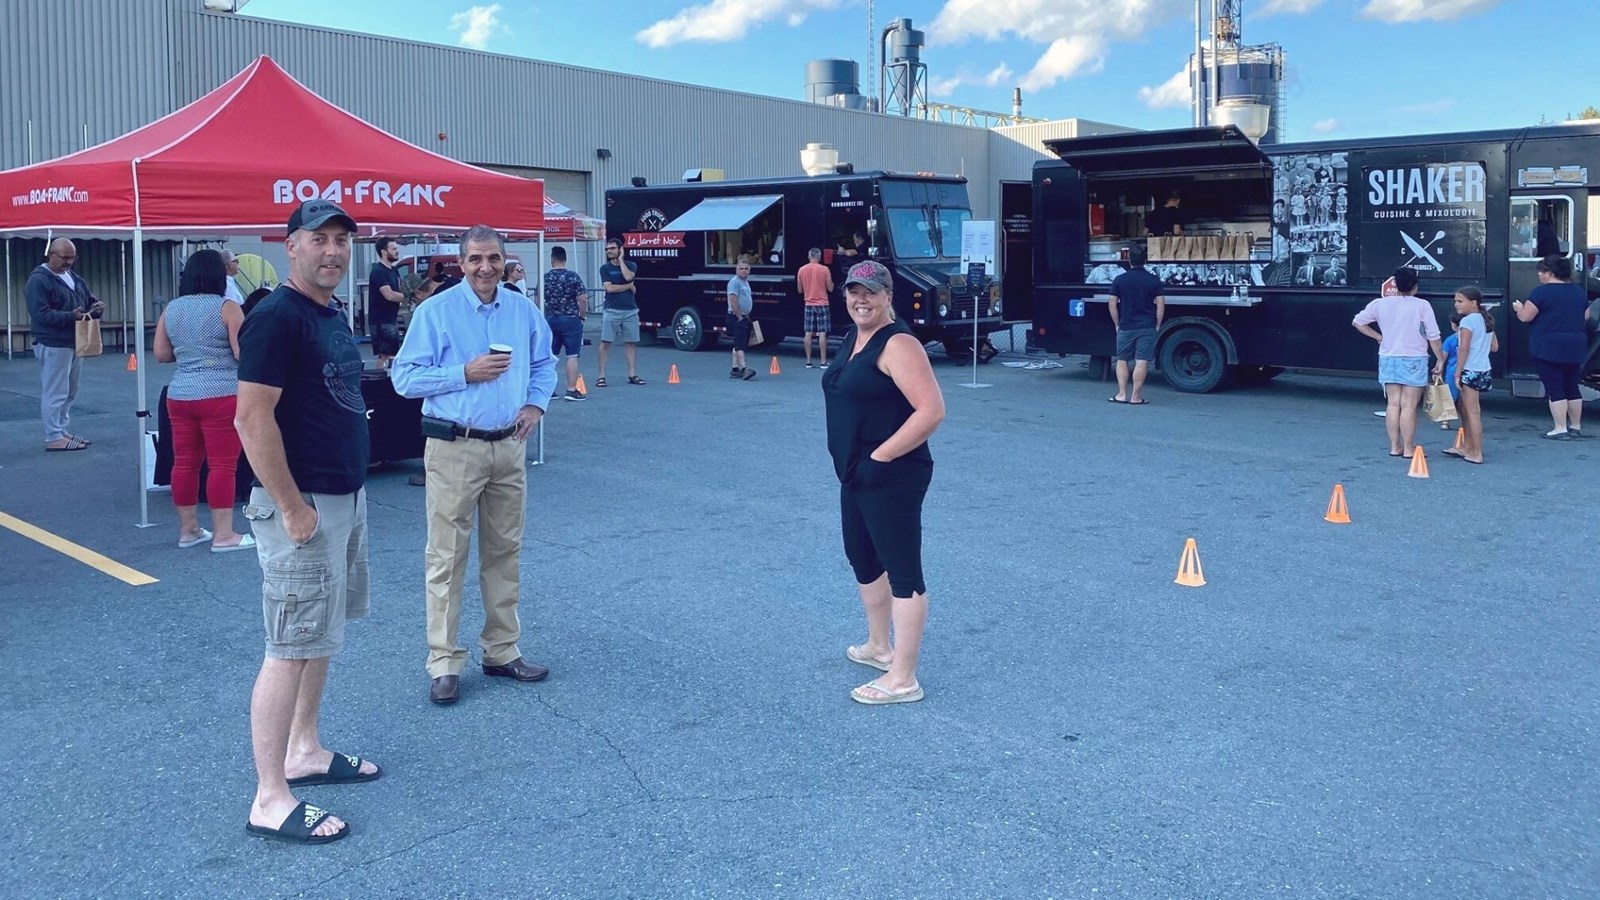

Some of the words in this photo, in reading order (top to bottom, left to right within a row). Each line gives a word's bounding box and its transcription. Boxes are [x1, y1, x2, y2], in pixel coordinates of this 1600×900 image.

[1368, 165, 1485, 206] SHAKER
[273, 179, 453, 208] BOA-FRANC
[641, 210, 652, 223] FOOD
[652, 210, 665, 223] TRUCK
[1374, 210, 1410, 218] CUISINE
[1414, 209, 1421, 217] &
[1425, 208, 1477, 217] MIXOLOGIE
[628, 235, 636, 245] Le
[637, 234, 660, 246] Jarret
[663, 235, 680, 246] Noir
[1420, 231, 1425, 239] S
[629, 249, 652, 257] CUISINE
[654, 249, 679, 257] NOMADE
[1401, 247, 1405, 255] C
